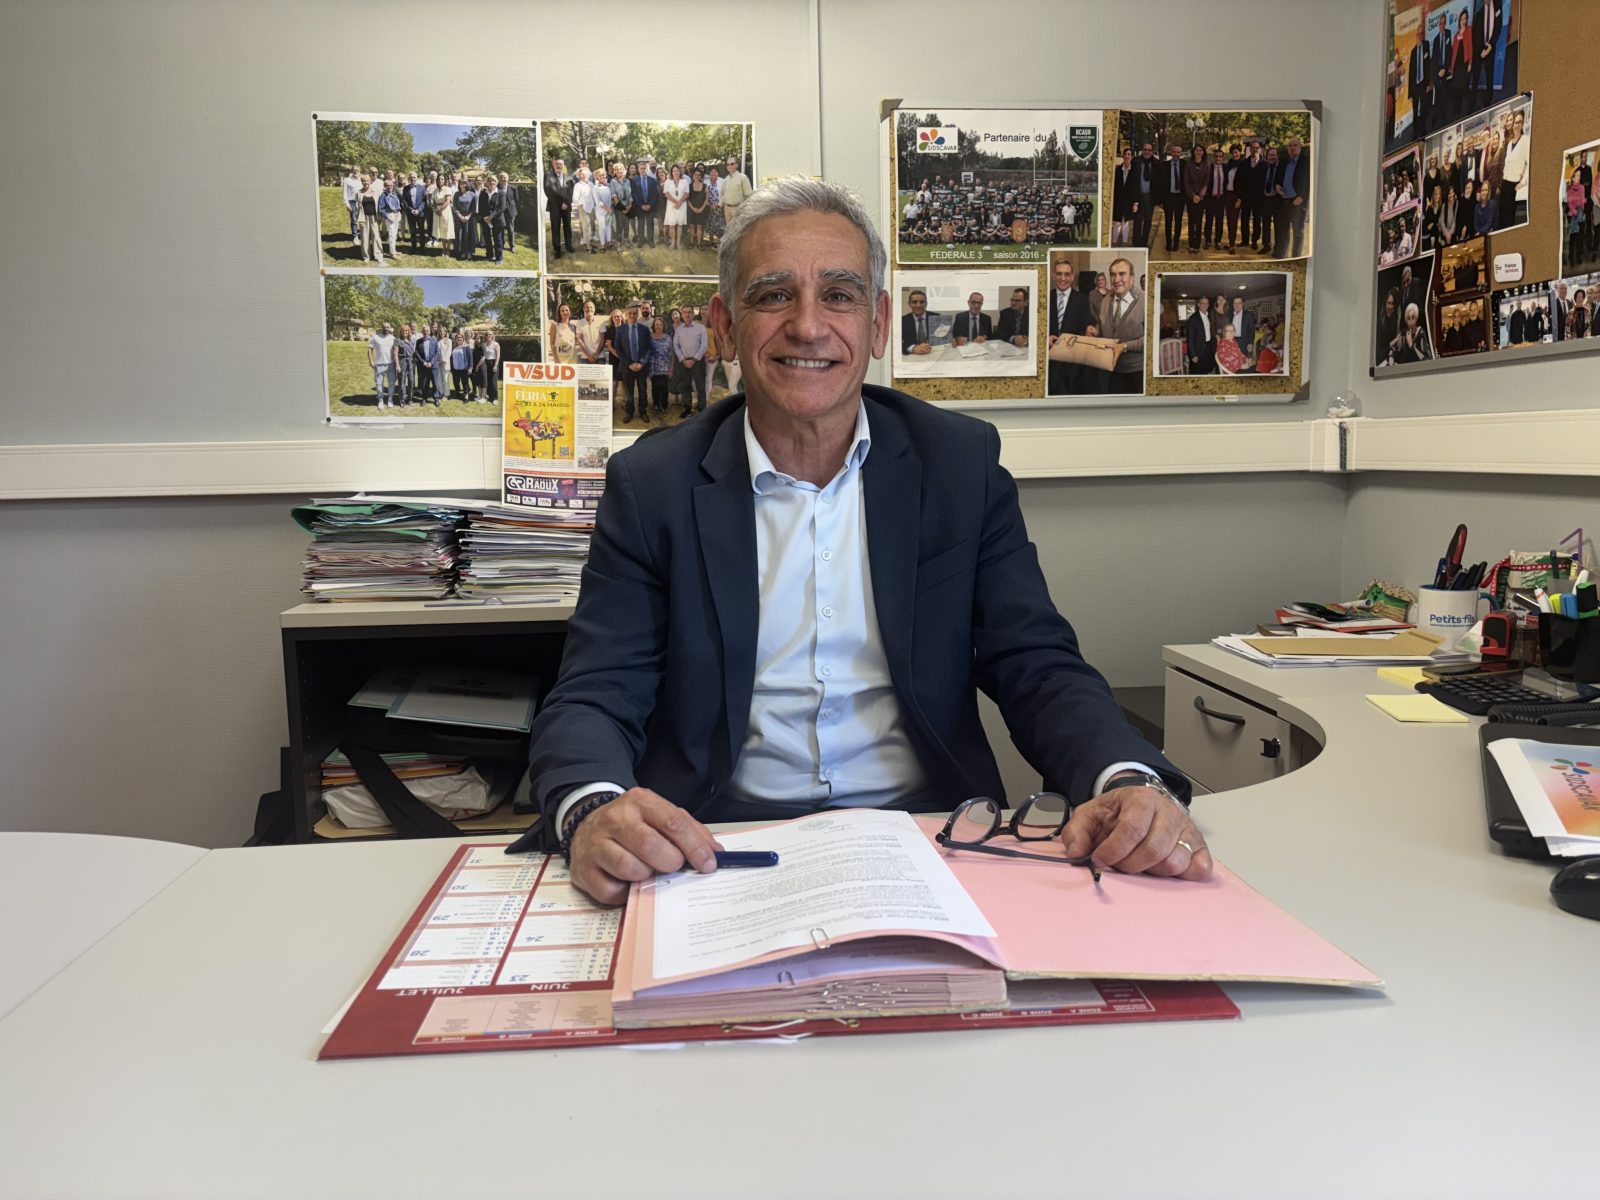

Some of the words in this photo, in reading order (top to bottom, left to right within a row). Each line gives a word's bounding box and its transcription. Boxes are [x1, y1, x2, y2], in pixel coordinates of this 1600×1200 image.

[984, 133, 1030, 142] Partenaire
[1036, 133, 1047, 142] du
[930, 251, 975, 259] FEDERALE
[977, 251, 983, 259] 3
[993, 251, 1017, 259] saison
[1020, 251, 1039, 259] 2016
[509, 974, 530, 982] 23
[530, 982, 572, 991] JUIN
[395, 987, 466, 996] JUILLET
